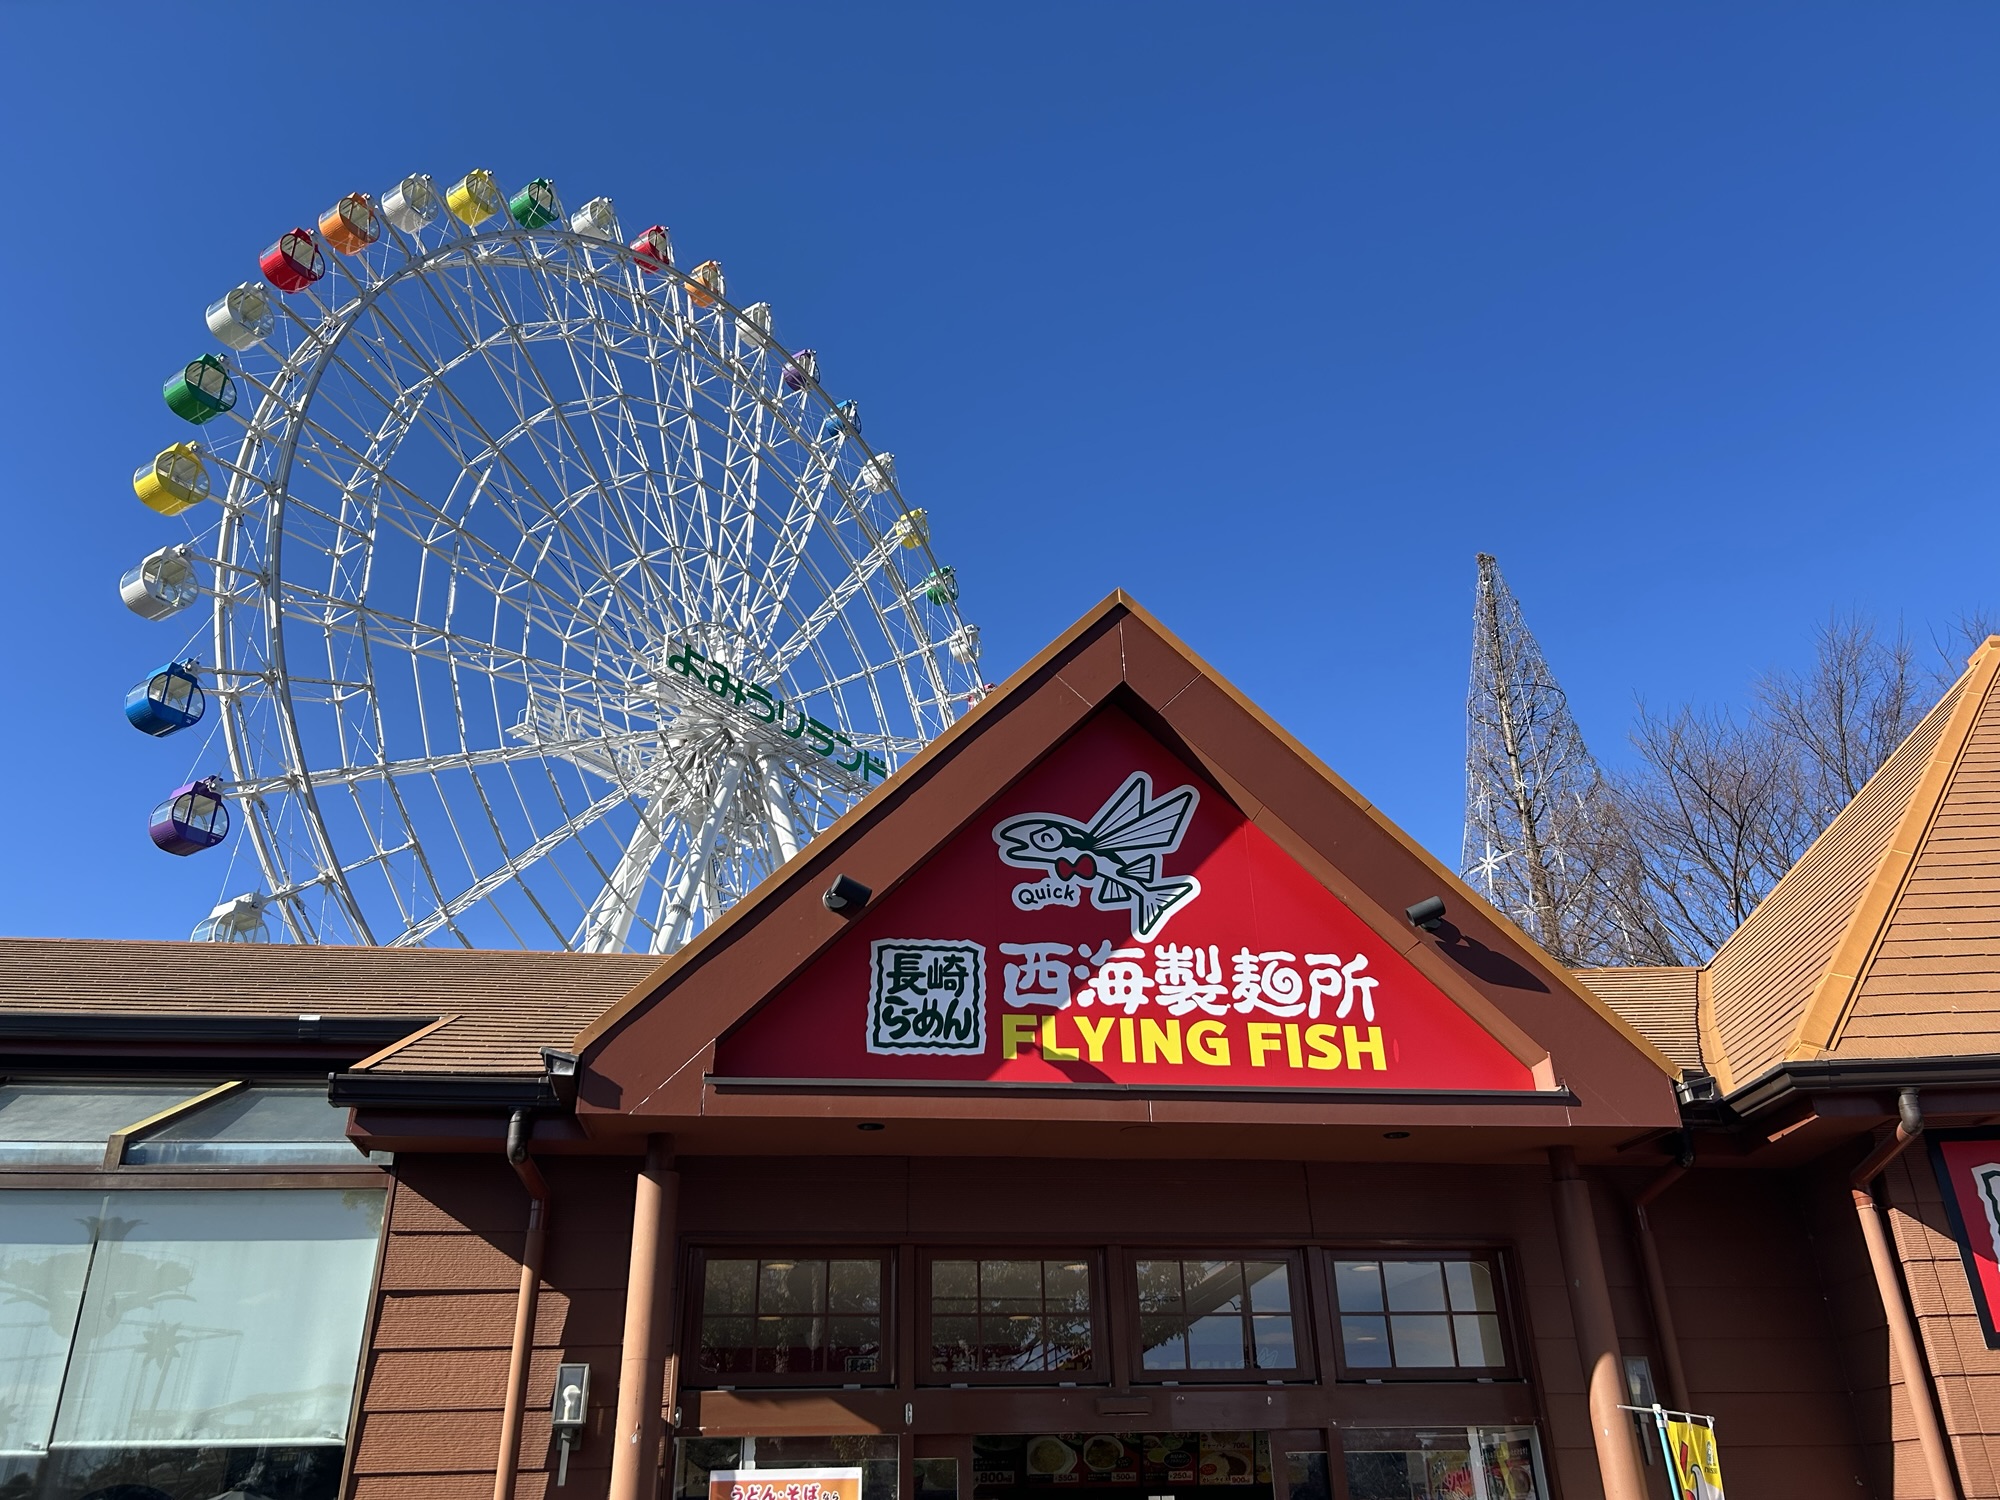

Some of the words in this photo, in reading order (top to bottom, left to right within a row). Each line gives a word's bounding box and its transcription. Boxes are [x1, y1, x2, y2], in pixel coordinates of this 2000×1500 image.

[669, 643, 887, 781] よみうりランド
[1018, 884, 1074, 904] Quick
[886, 953, 969, 997] 長崎
[999, 940, 1379, 1022] 西海製麺所
[882, 995, 971, 1040] らめん
[1001, 1014, 1231, 1067] FLYING
[1247, 1022, 1388, 1072] FISH
